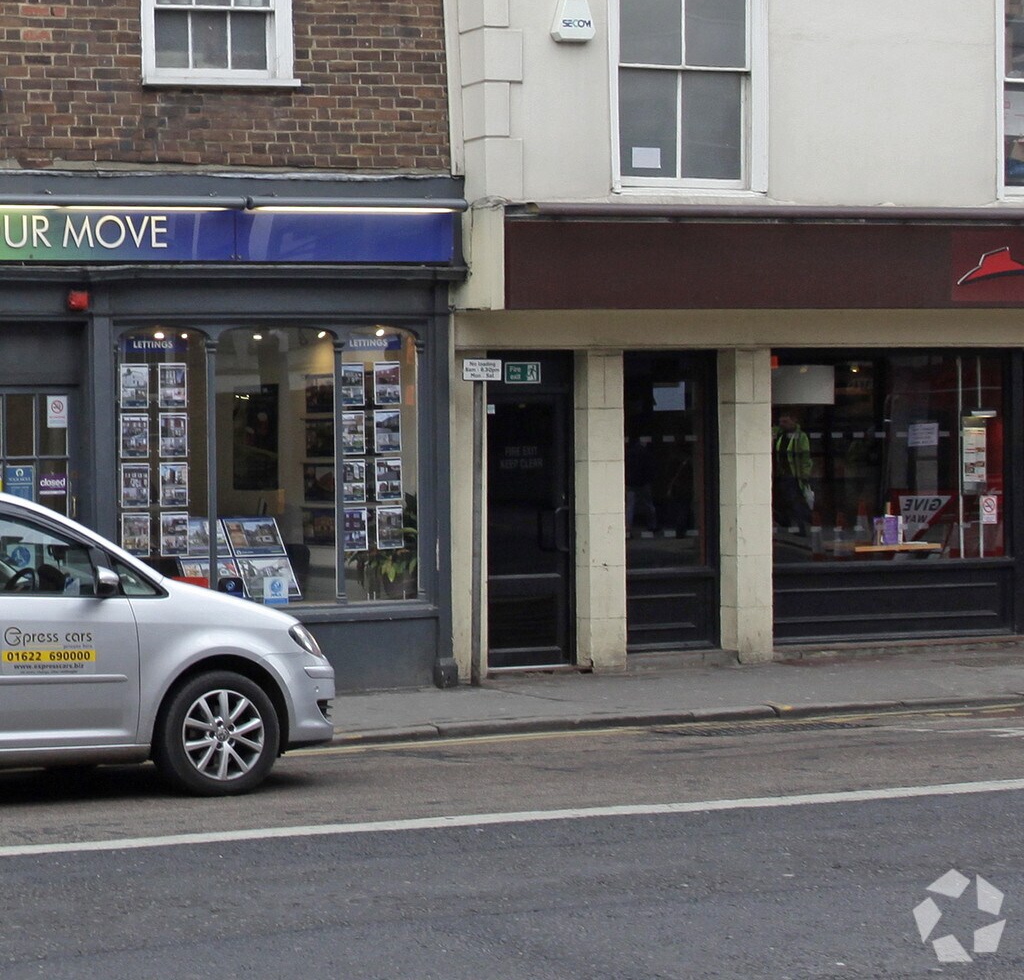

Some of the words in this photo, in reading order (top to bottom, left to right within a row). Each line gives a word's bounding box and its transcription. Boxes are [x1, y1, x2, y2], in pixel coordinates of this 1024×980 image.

[562, 19, 592, 28] SECOM
[62, 214, 168, 249] MOVE
[133, 340, 174, 349] LETTINGS
[349, 339, 388, 348] LETTINGS
[509, 365, 522, 373] Fire
[39, 477, 66, 488] closed
[65, 632, 93, 642] cars
[7, 651, 42, 661] 01622
[49, 651, 91, 661] 690000
